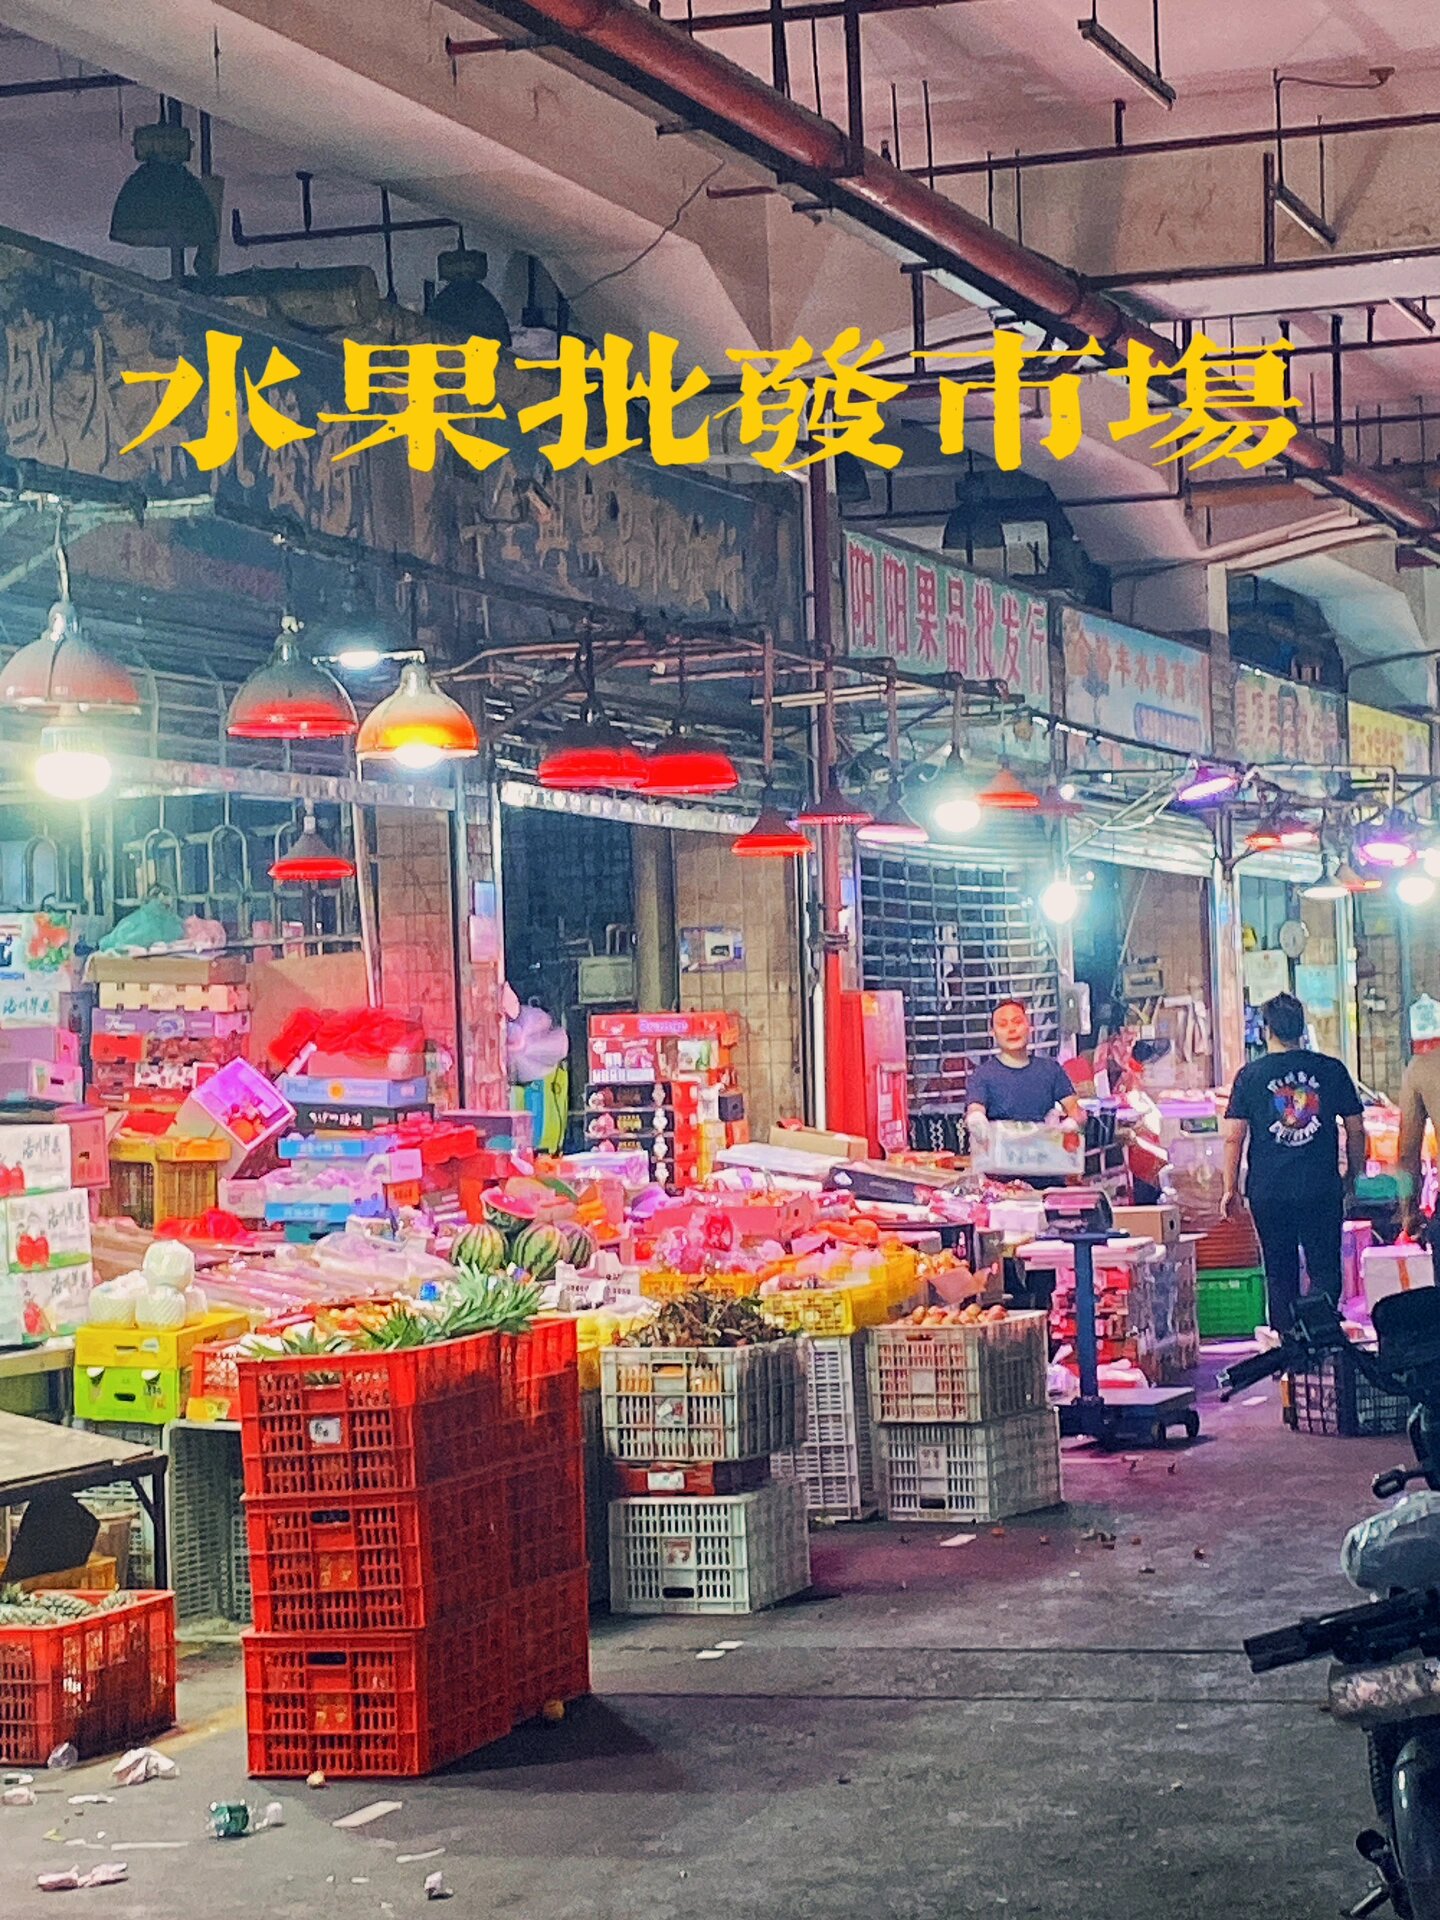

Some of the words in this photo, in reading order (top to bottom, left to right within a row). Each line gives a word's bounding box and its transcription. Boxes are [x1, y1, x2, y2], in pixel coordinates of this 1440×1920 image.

[848, 540, 1046, 695] 阳阳果品批发行
